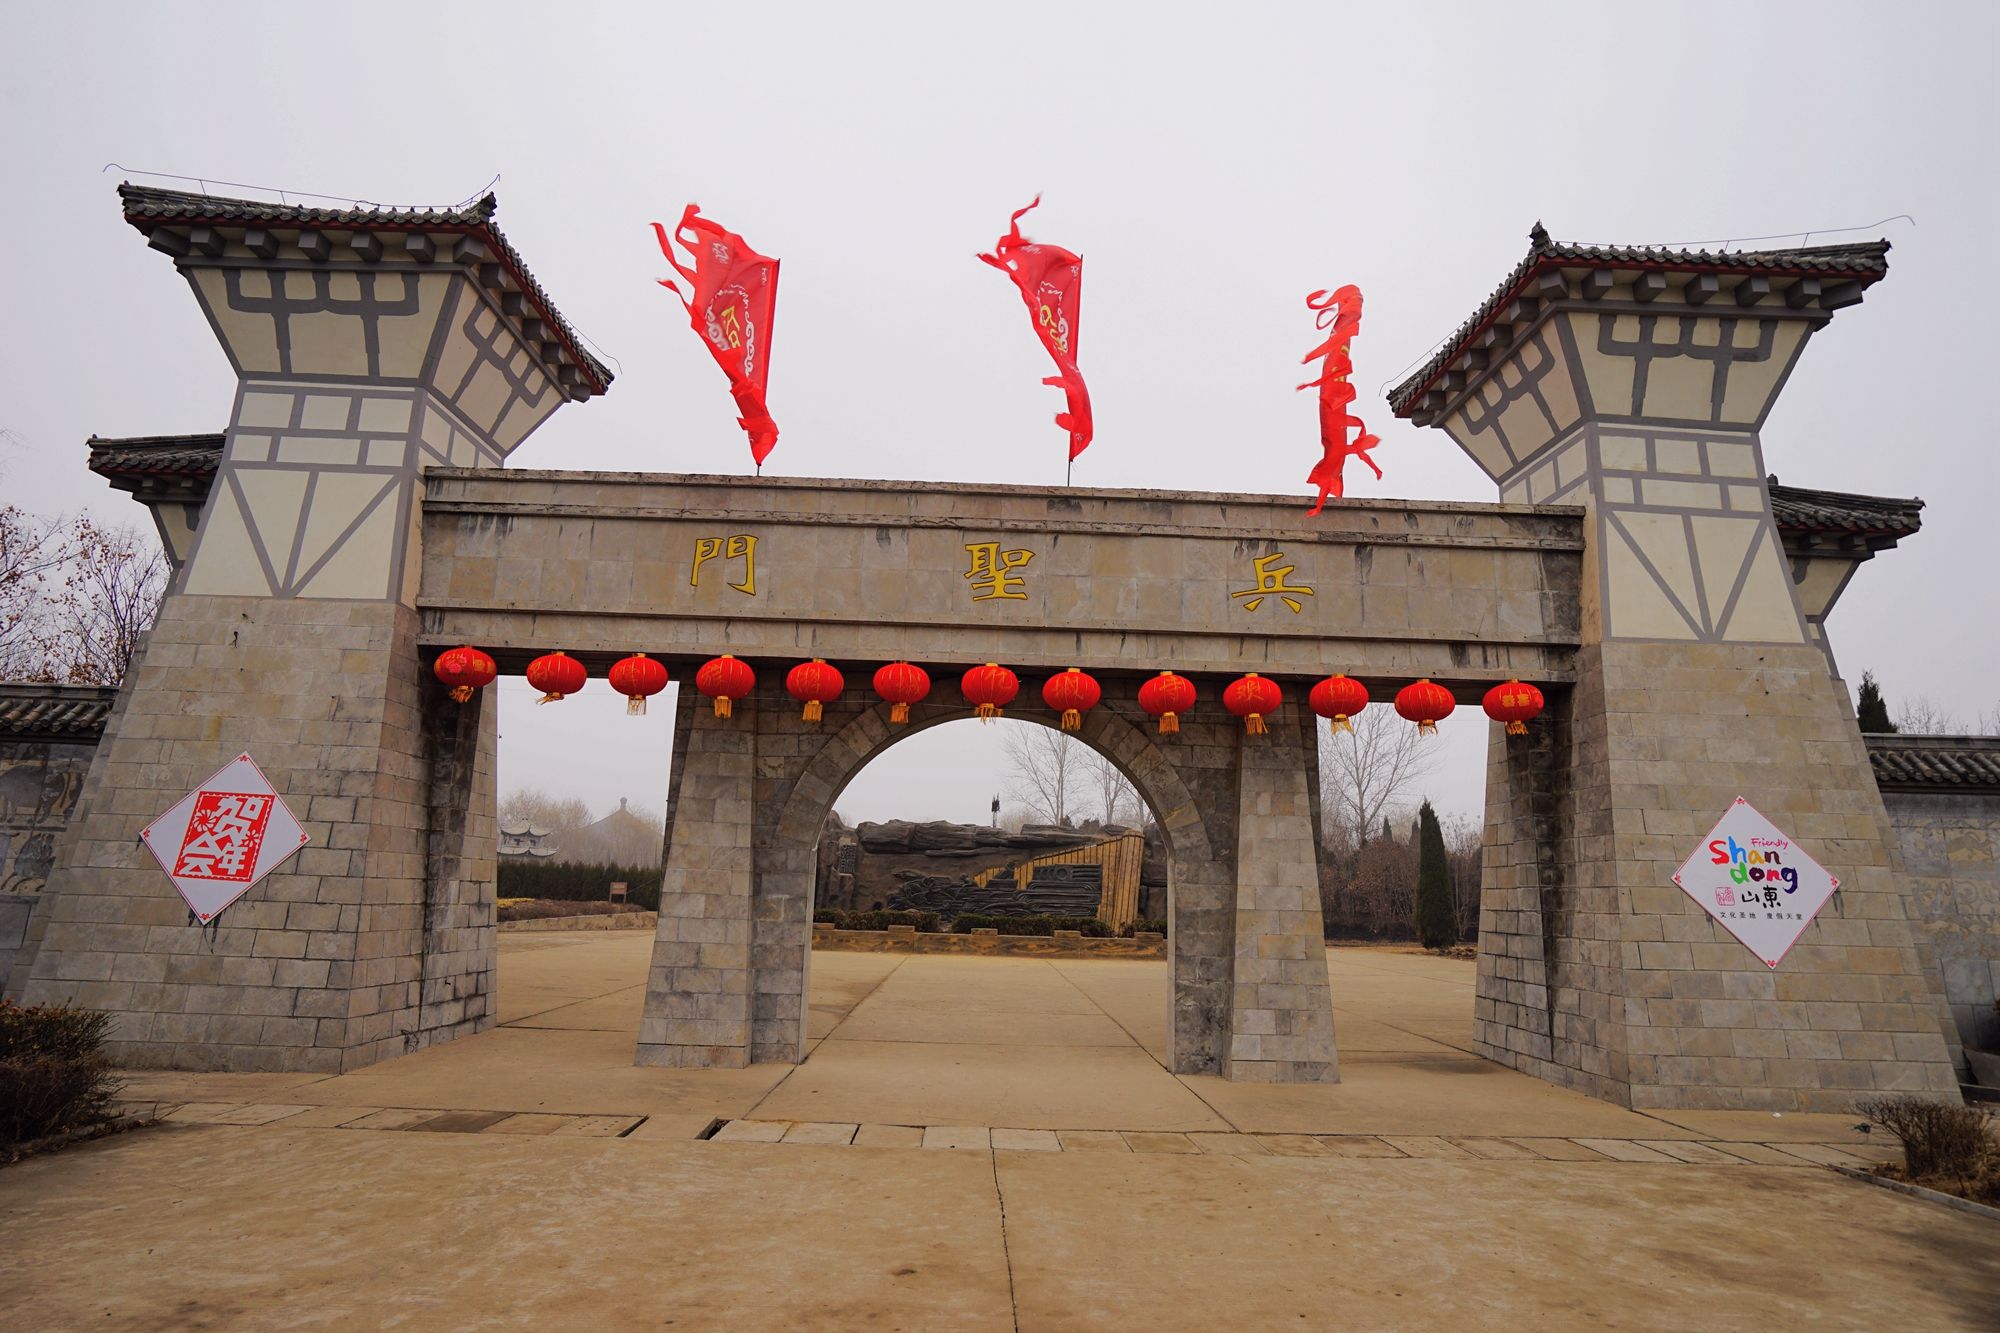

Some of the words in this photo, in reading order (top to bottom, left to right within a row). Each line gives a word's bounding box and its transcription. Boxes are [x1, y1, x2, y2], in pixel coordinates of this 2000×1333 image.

[1709, 836, 1781, 865] Shan
[1751, 837, 1788, 850] Friendly
[1730, 861, 1798, 894] dong
